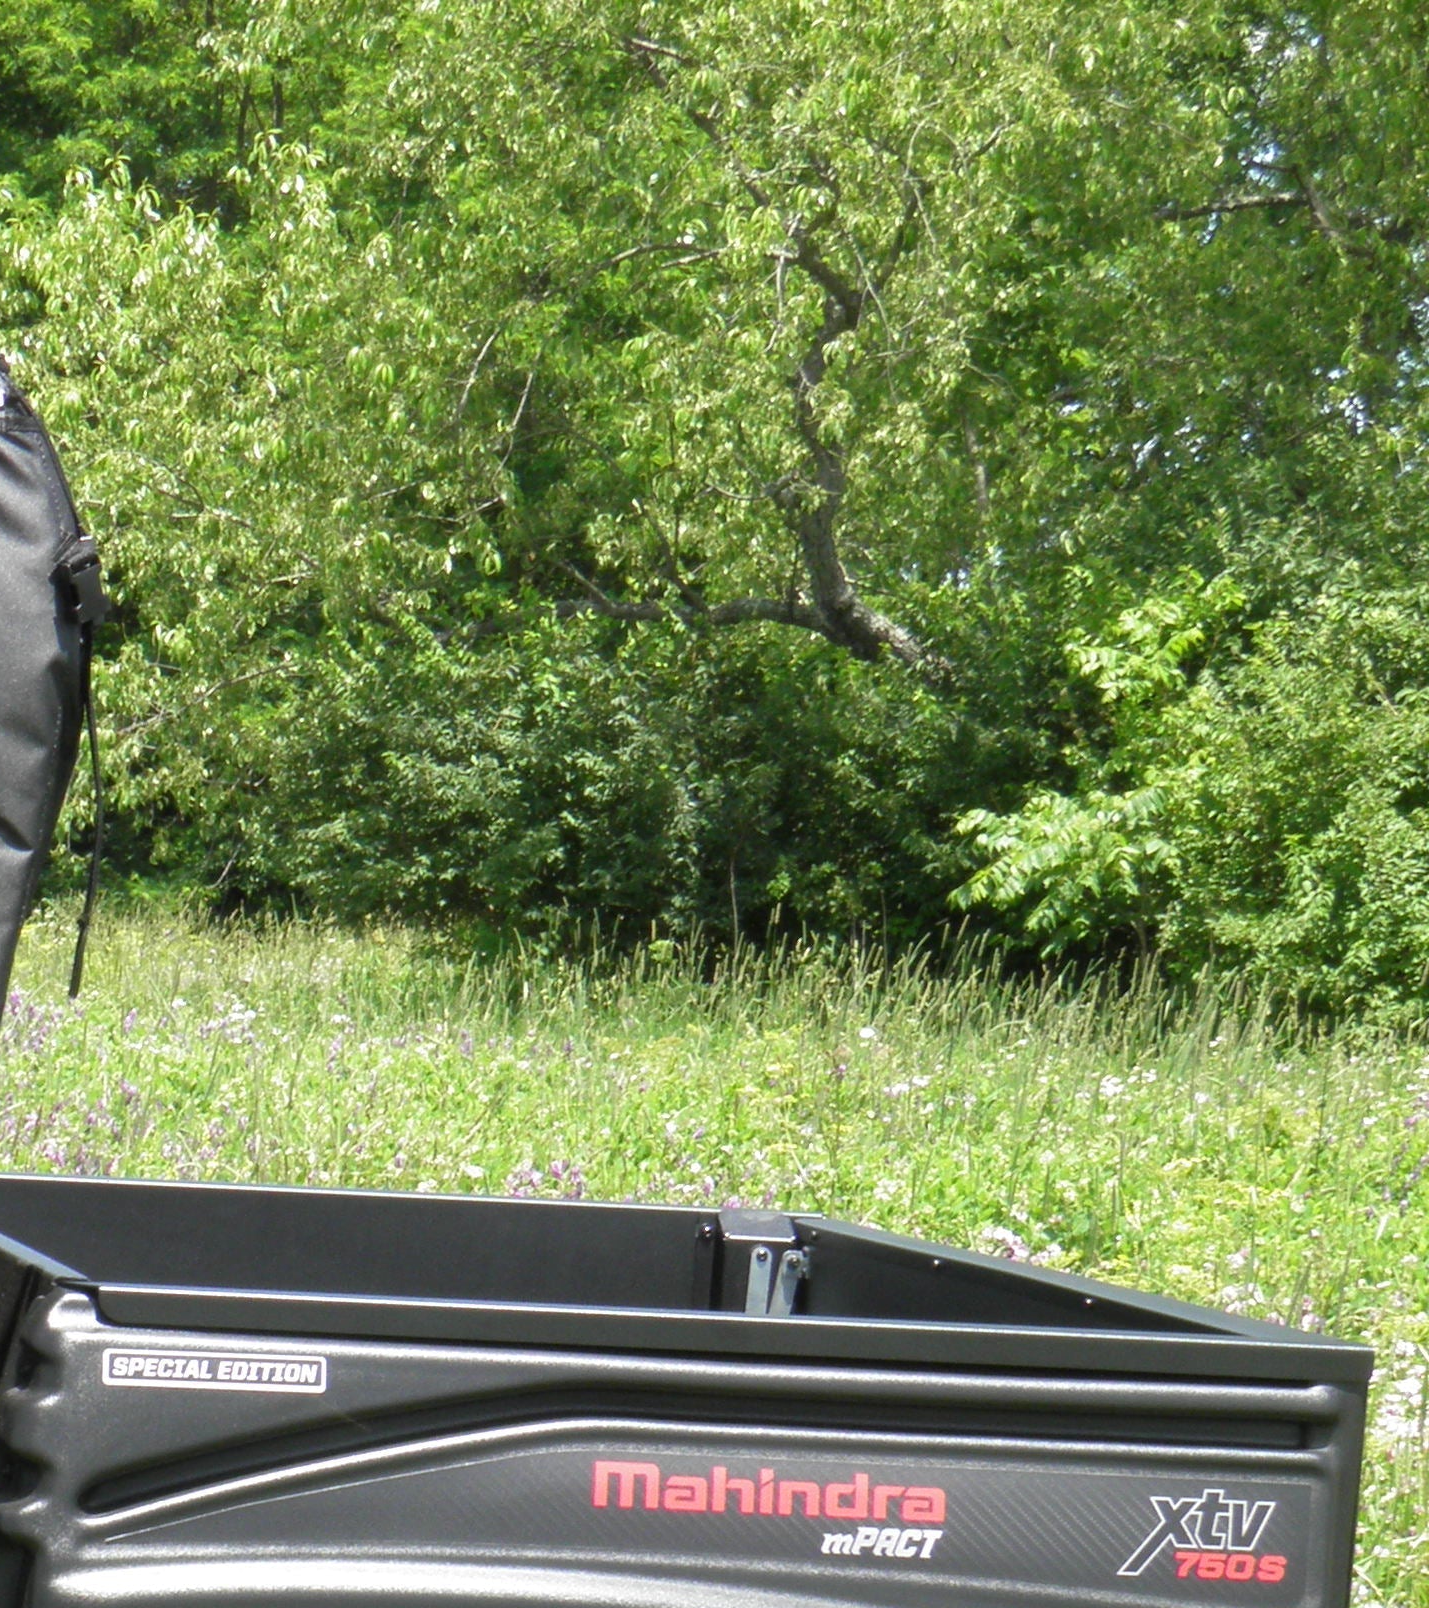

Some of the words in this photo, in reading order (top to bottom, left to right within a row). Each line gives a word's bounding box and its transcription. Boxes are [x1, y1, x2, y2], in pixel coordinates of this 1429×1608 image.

[112, 1356, 213, 1380] SPECIAL
[217, 1360, 319, 1384] EDITION
[592, 1460, 947, 1524] Mahindra
[821, 1526, 943, 1559] mPACT
[1173, 1550, 1288, 1584] 750S
